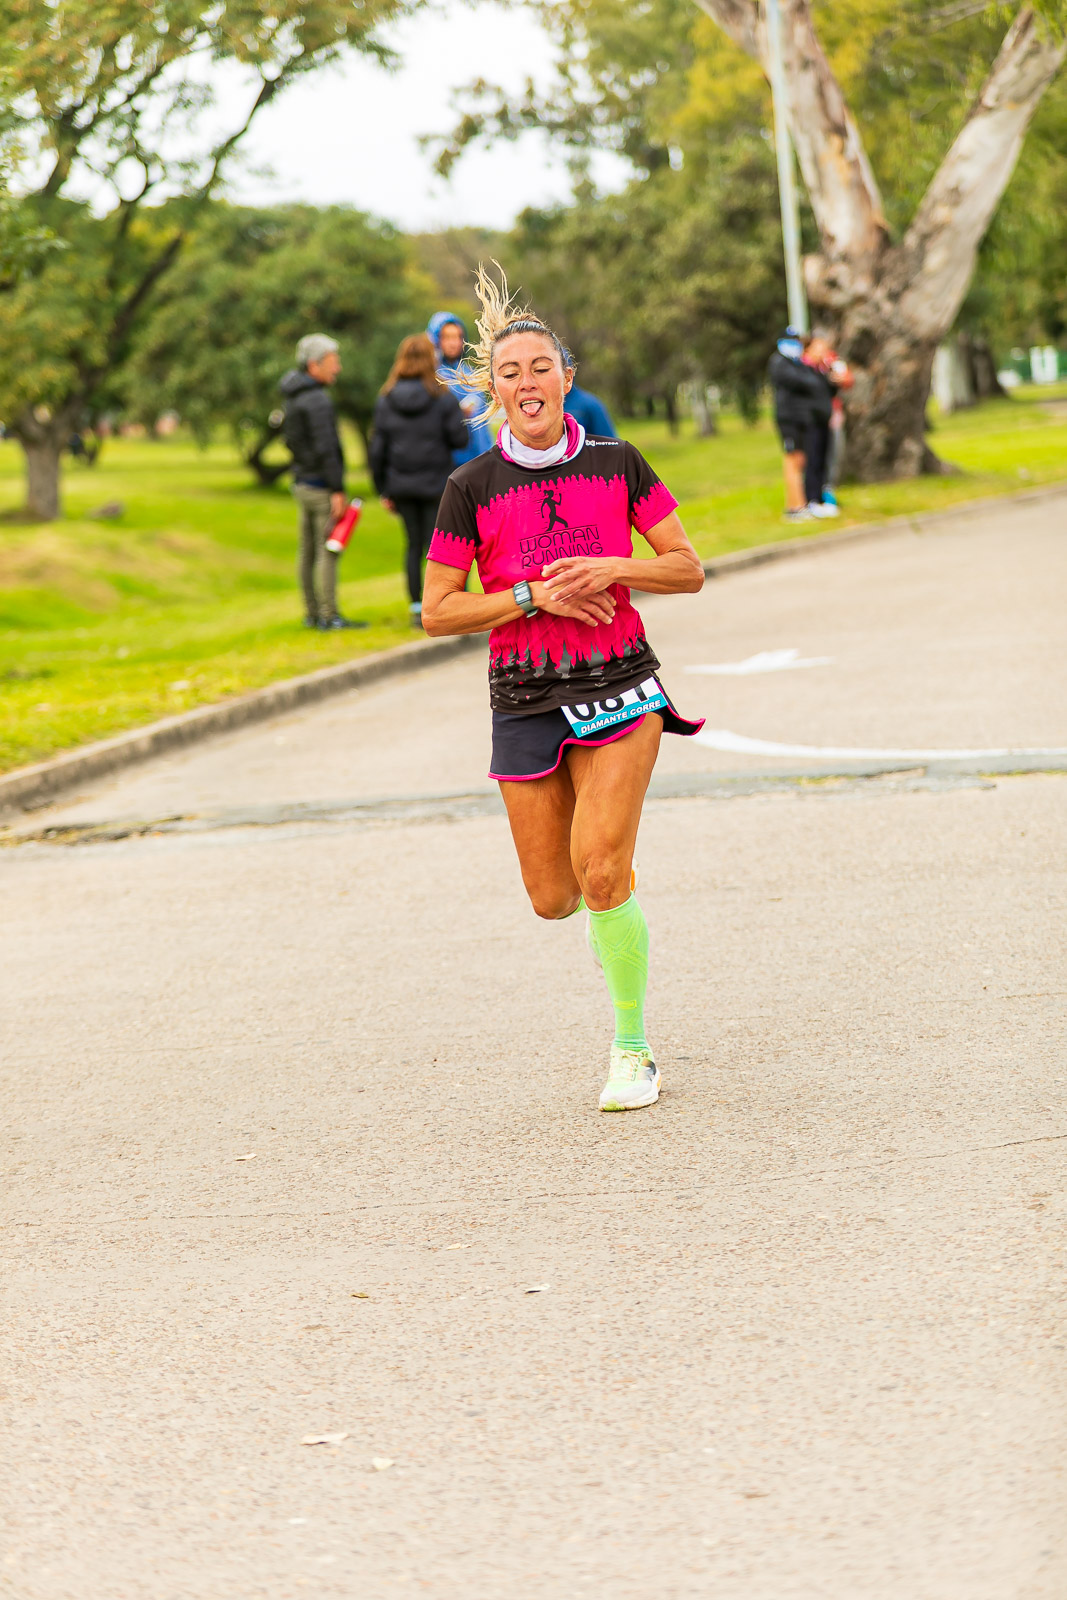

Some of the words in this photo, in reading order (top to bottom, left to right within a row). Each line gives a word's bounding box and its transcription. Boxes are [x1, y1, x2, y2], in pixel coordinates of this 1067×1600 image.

[520, 527, 600, 554] WOMAN
[522, 542, 603, 569] RUNNING
[580, 710, 628, 734] DIAMANTE
[630, 699, 661, 715] CORRE
